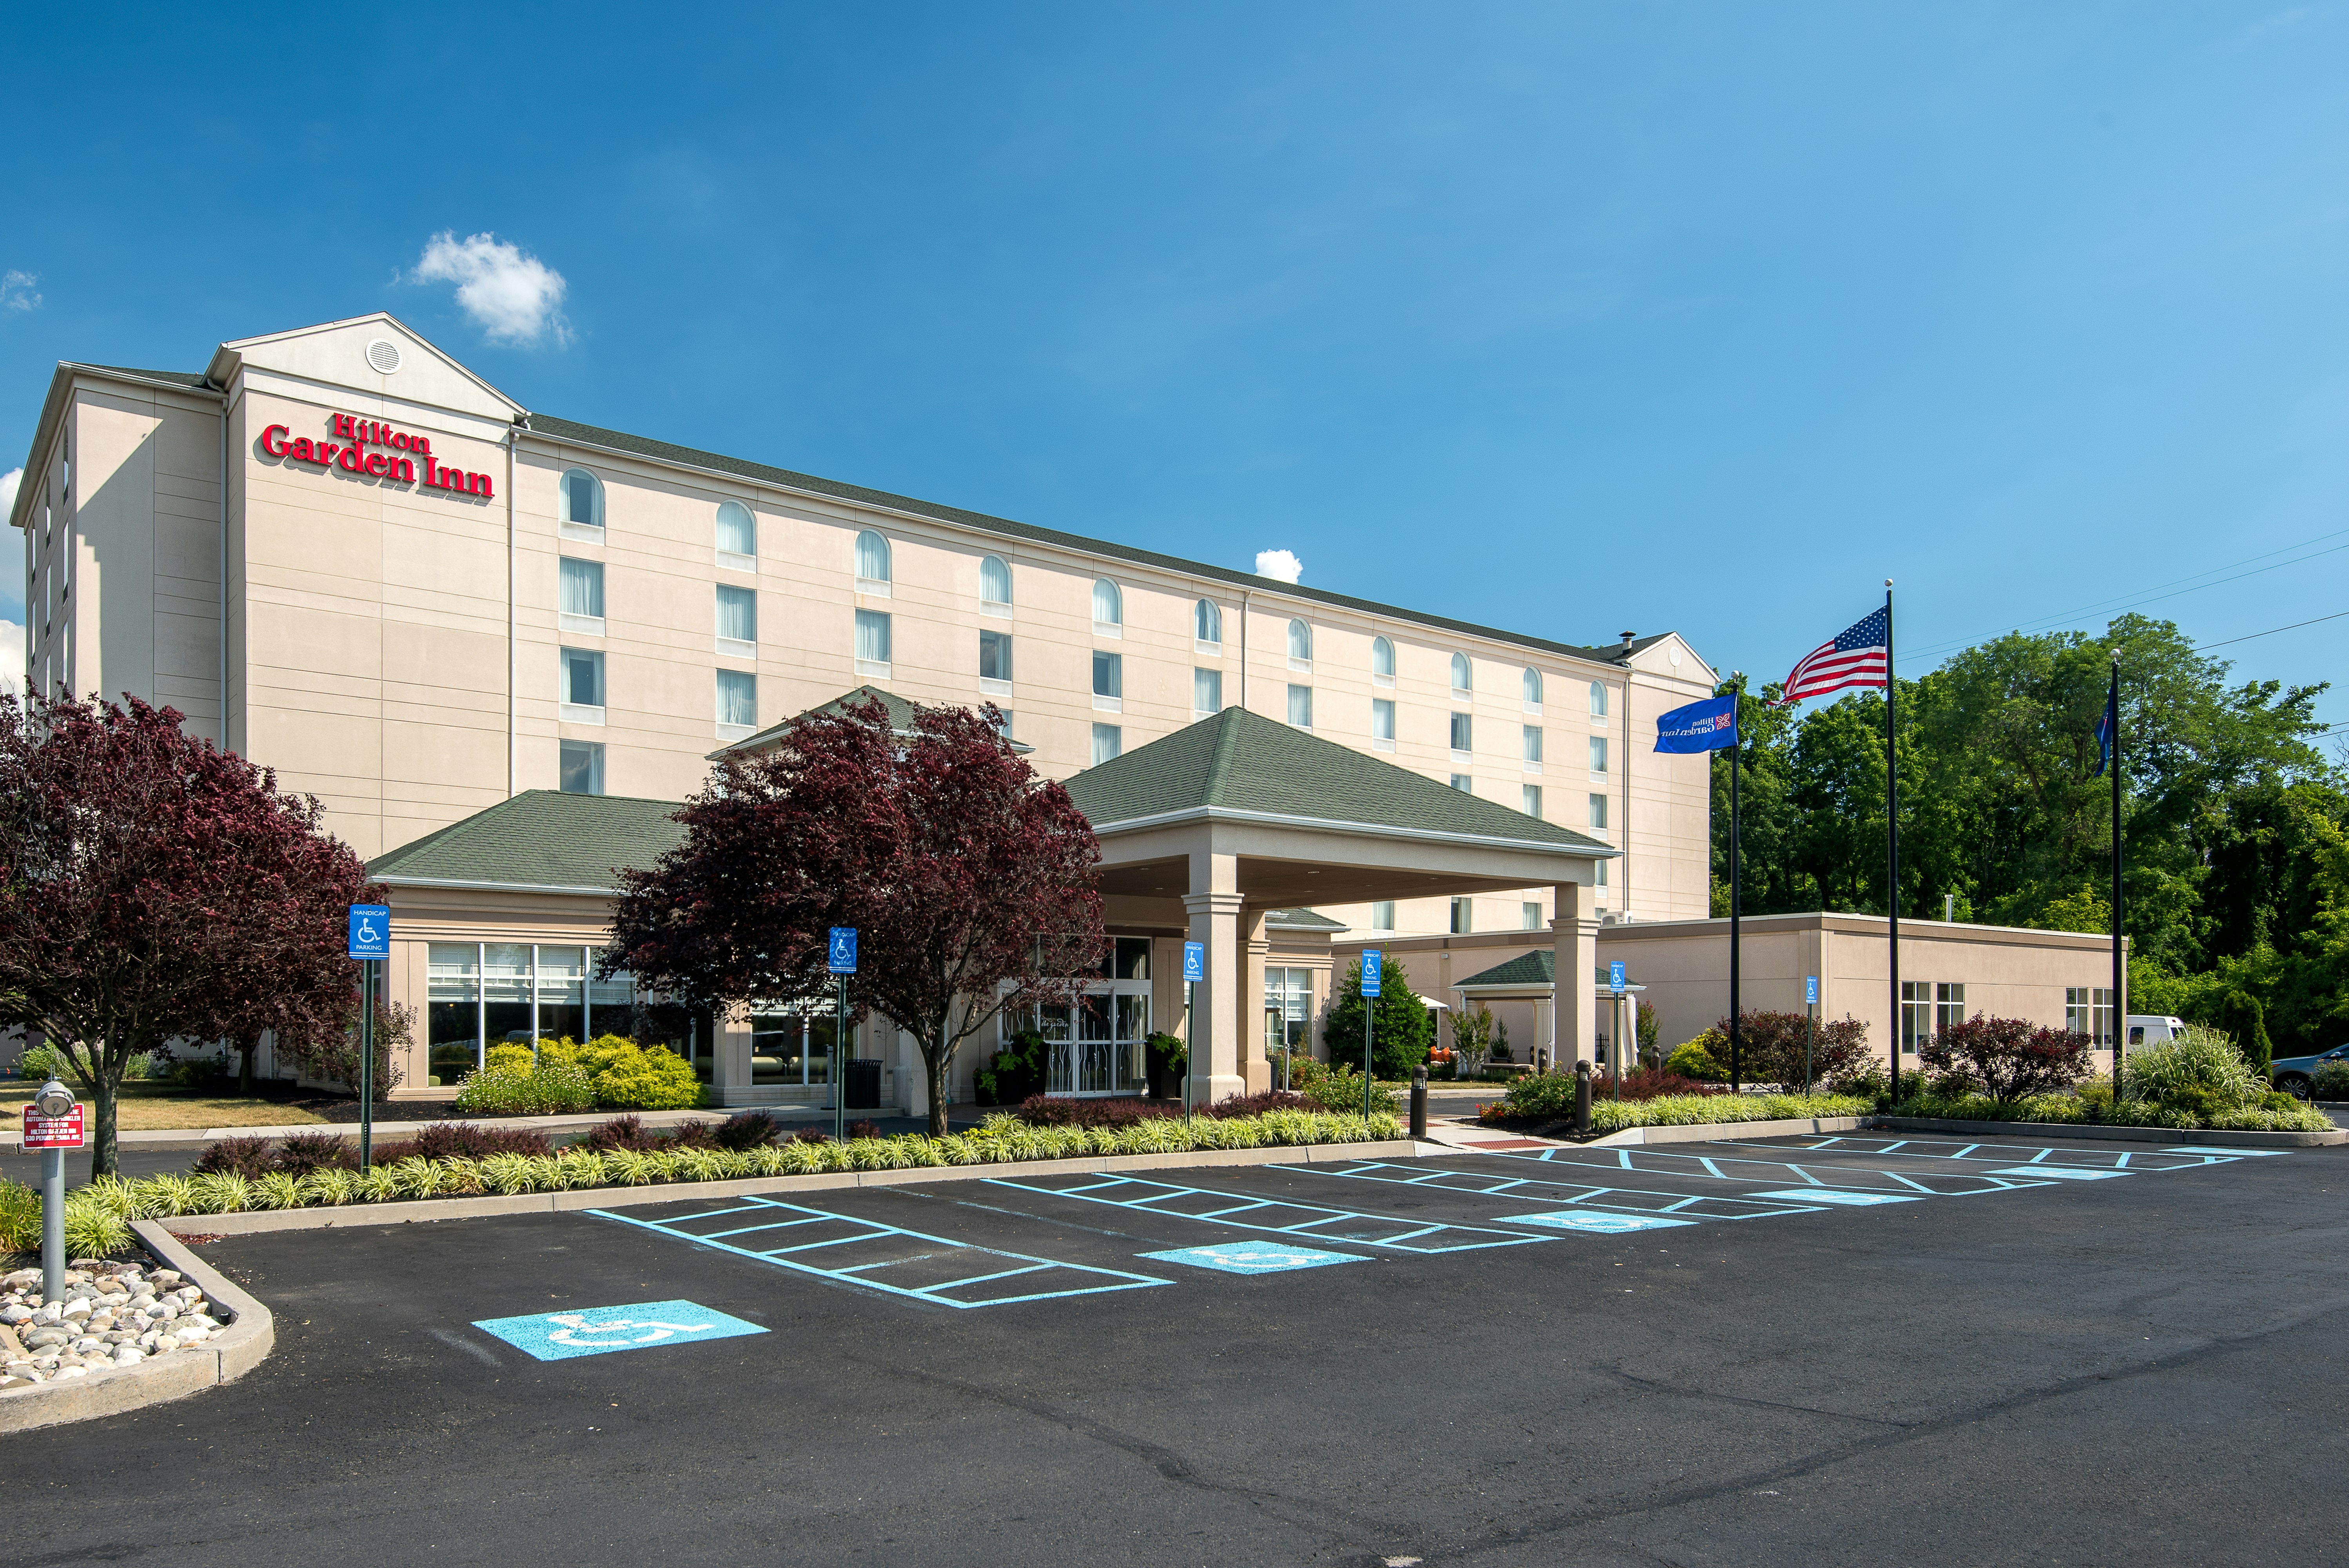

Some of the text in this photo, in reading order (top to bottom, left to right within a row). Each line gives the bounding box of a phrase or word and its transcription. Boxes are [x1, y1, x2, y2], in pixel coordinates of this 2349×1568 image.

[262, 424, 495, 497] Garden Inn
[333, 413, 432, 454] Hilton
